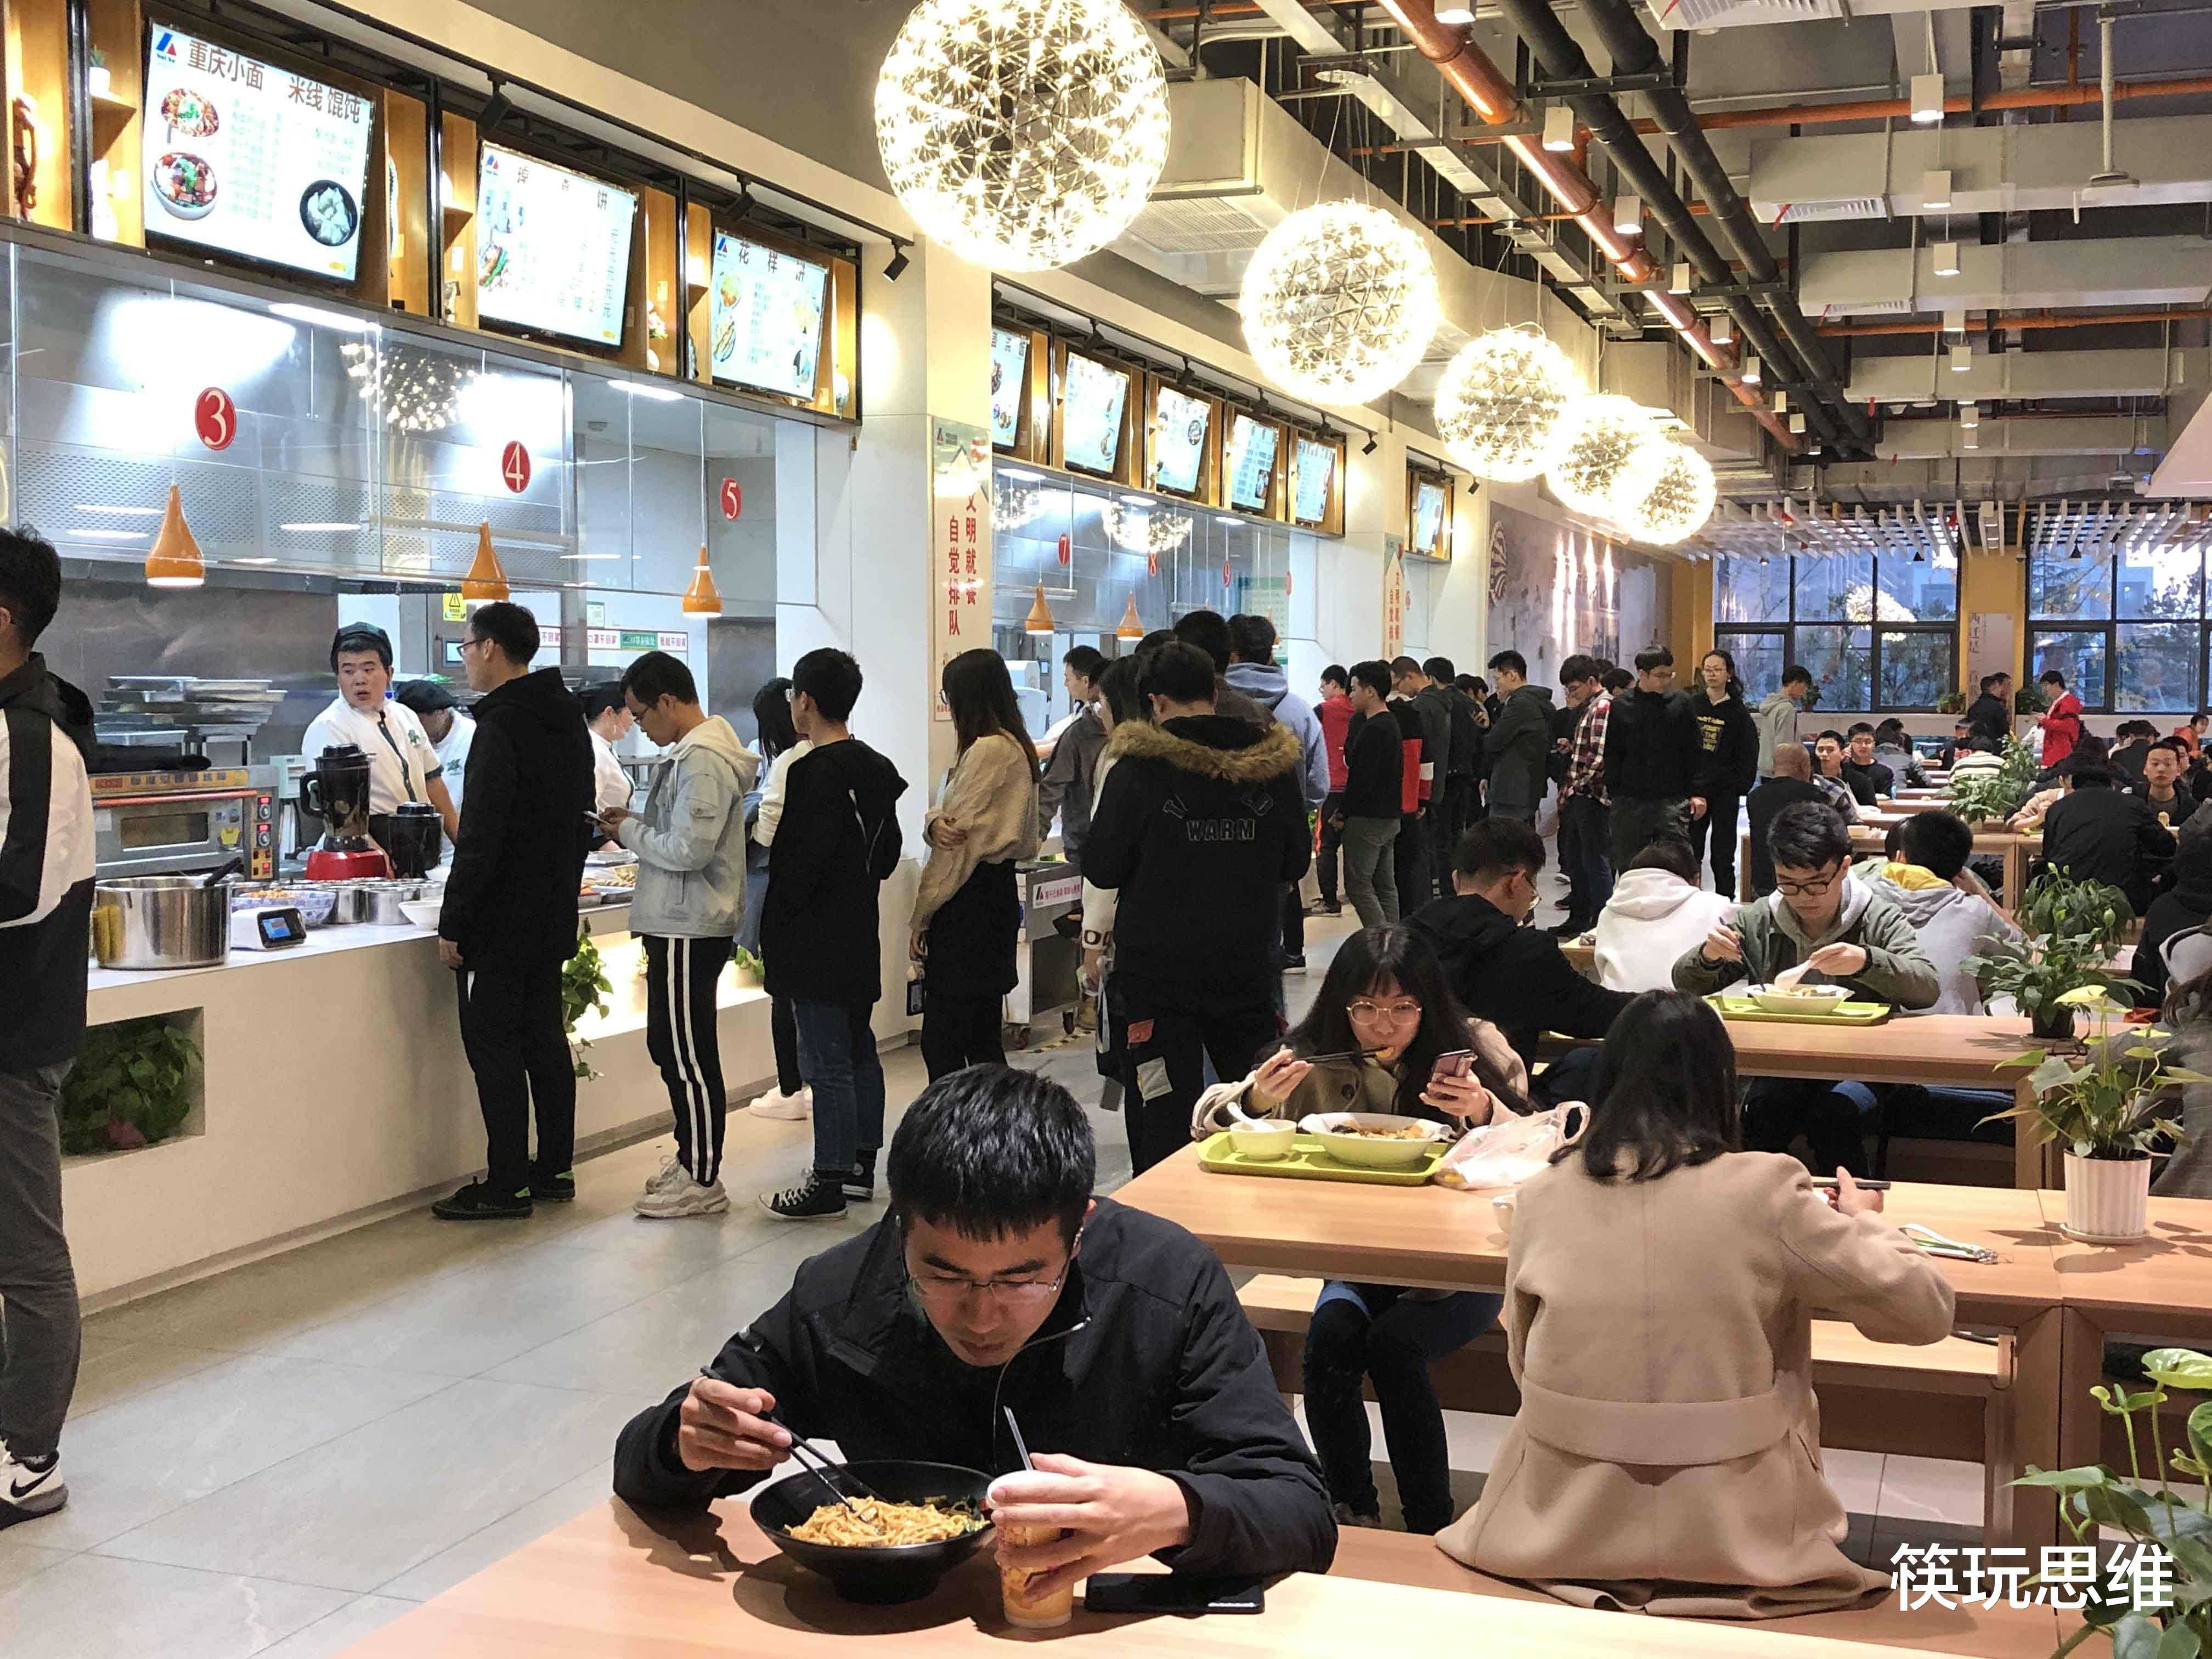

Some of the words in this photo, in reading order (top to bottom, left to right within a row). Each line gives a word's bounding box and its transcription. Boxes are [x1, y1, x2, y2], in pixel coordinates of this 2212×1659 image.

[188, 40, 266, 91] 重庆小面
[289, 76, 323, 111] 米线
[328, 87, 361, 124] 馄饨
[204, 390, 227, 445] 3
[505, 443, 524, 492] 4
[727, 482, 737, 520] 5
[1060, 536, 1067, 565] 7
[1149, 552, 1157, 577] 8
[949, 515, 961, 636] 自觉排队
[1224, 566, 1231, 585] 9
